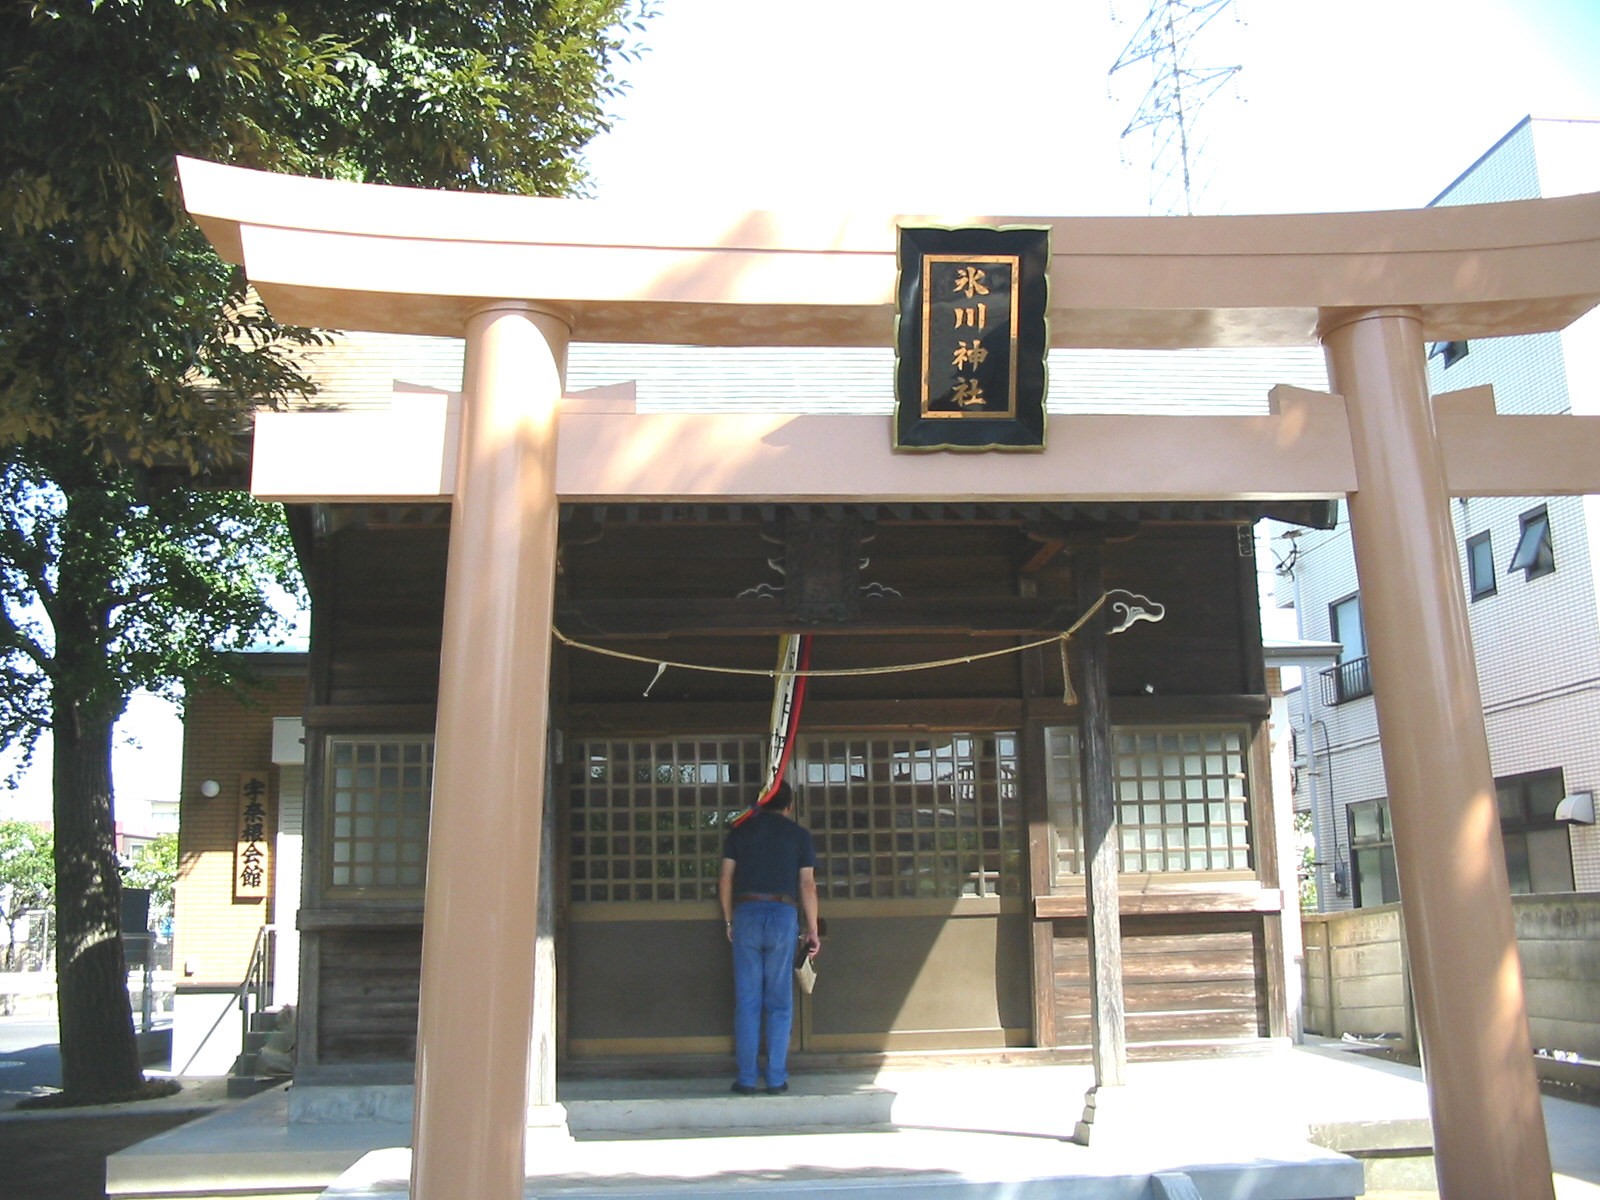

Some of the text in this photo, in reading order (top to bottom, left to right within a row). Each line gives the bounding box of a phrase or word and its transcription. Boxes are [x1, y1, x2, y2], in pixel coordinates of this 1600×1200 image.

[951, 266, 990, 407] 氷川神社
[240, 778, 266, 888] 宇奈根会館
